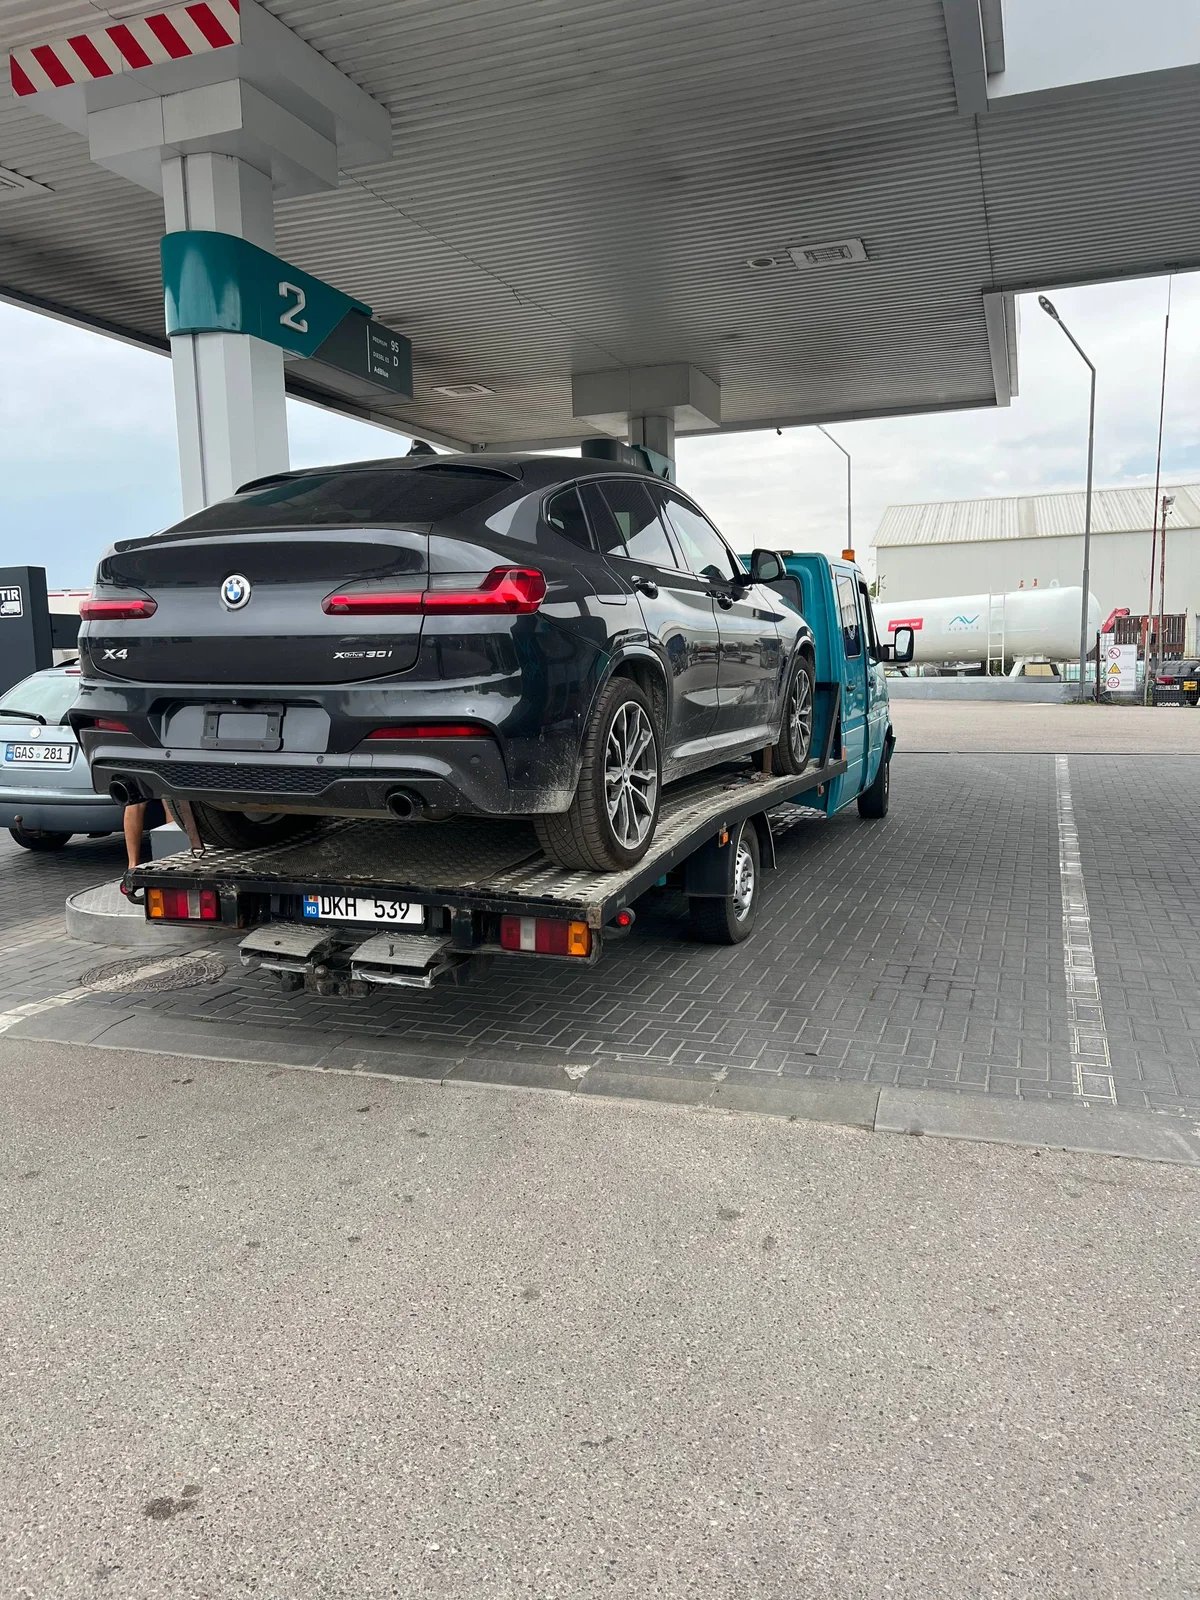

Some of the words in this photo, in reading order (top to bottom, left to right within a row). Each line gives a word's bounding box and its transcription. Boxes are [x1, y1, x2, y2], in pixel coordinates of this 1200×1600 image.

[279, 281, 308, 333] 2
[372, 335, 388, 347] PREMIUM
[391, 340, 399, 353] 95
[373, 351, 384, 361] DIESEL
[393, 356, 399, 367] D
[374, 366, 389, 378] AdBlue
[0, 590, 19, 601] TIR
[102, 648, 128, 660] X4
[15, 746, 34, 759] GAS
[43, 747, 63, 760] 281
[306, 905, 317, 915] MD
[320, 896, 357, 917] DKH
[373, 899, 410, 920] 539
